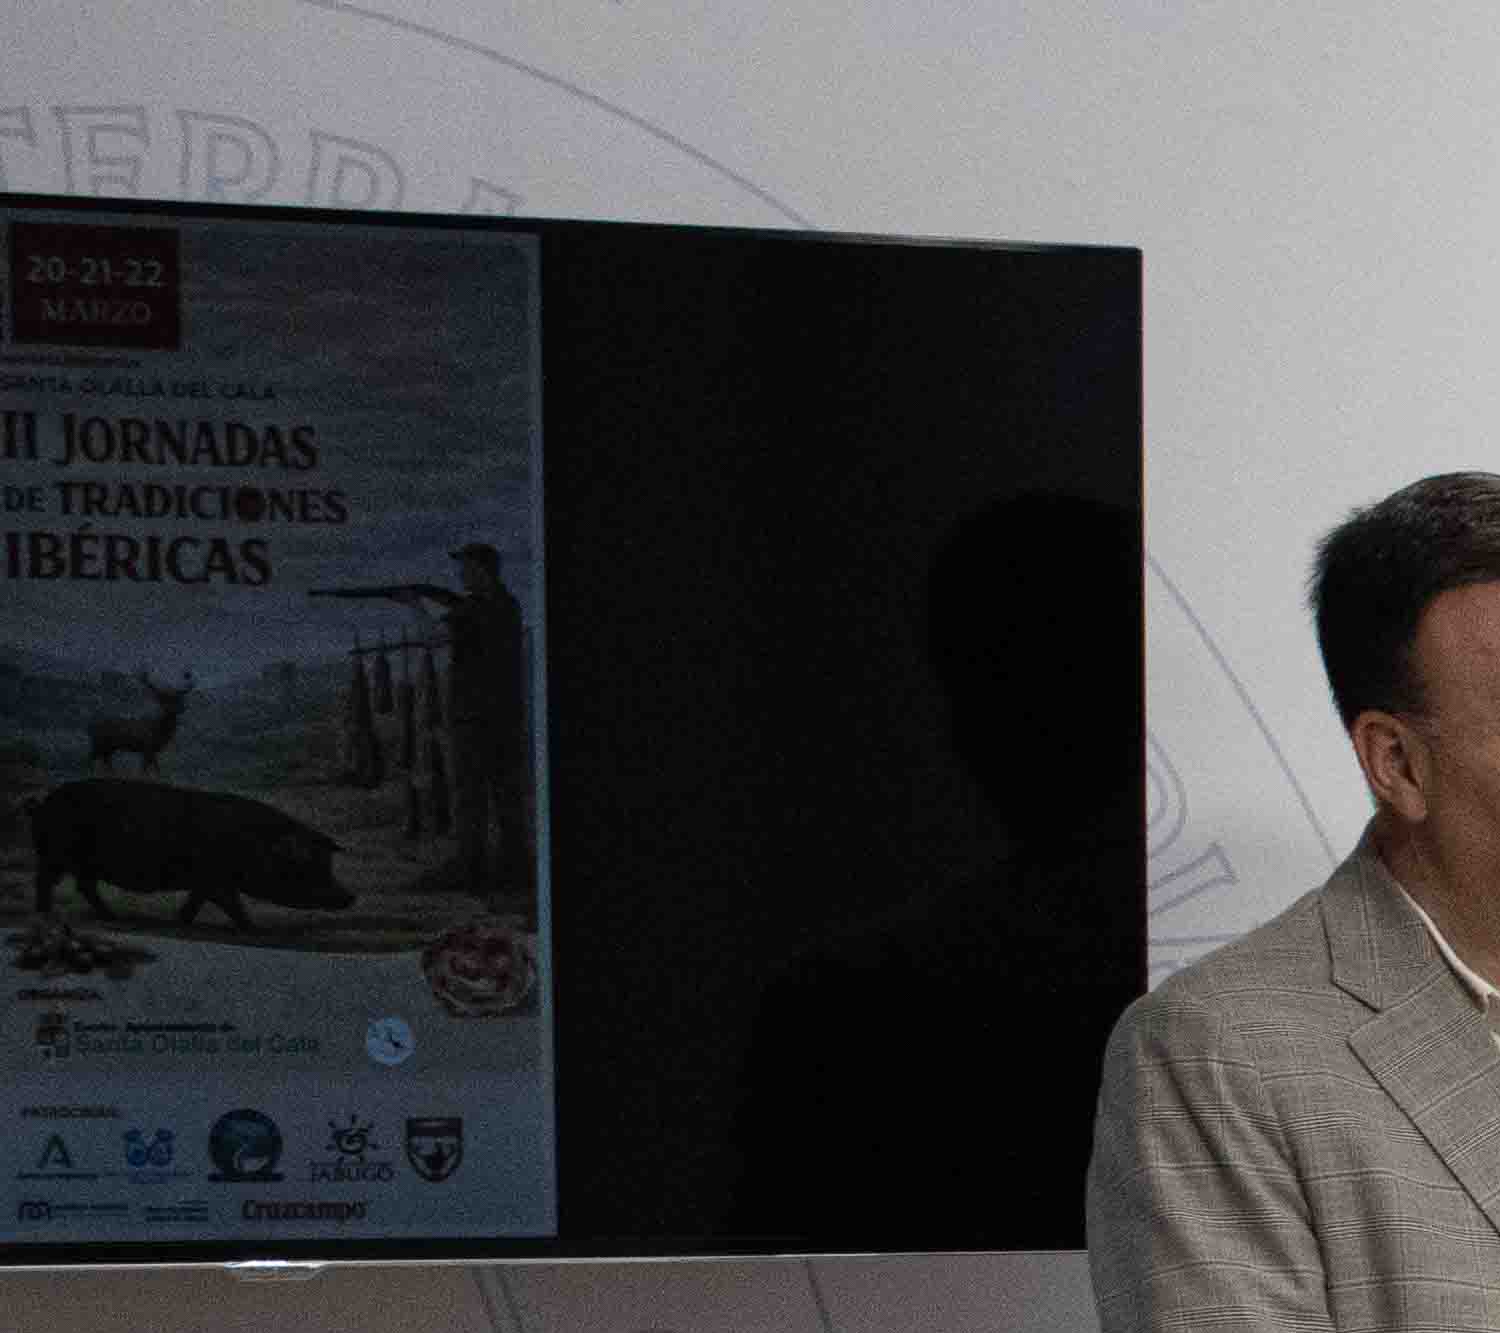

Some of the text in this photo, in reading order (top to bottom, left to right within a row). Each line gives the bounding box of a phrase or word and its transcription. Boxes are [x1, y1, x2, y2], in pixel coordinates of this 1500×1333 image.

[26, 255, 167, 288] 20-21-22
[40, 298, 152, 326] MARZO
[219, 382, 277, 401] CALA
[55, 413, 320, 472] JORNADAS
[4, 481, 349, 526] DE TRADICIONES
[5, 523, 273, 587] IBÉRICAS
